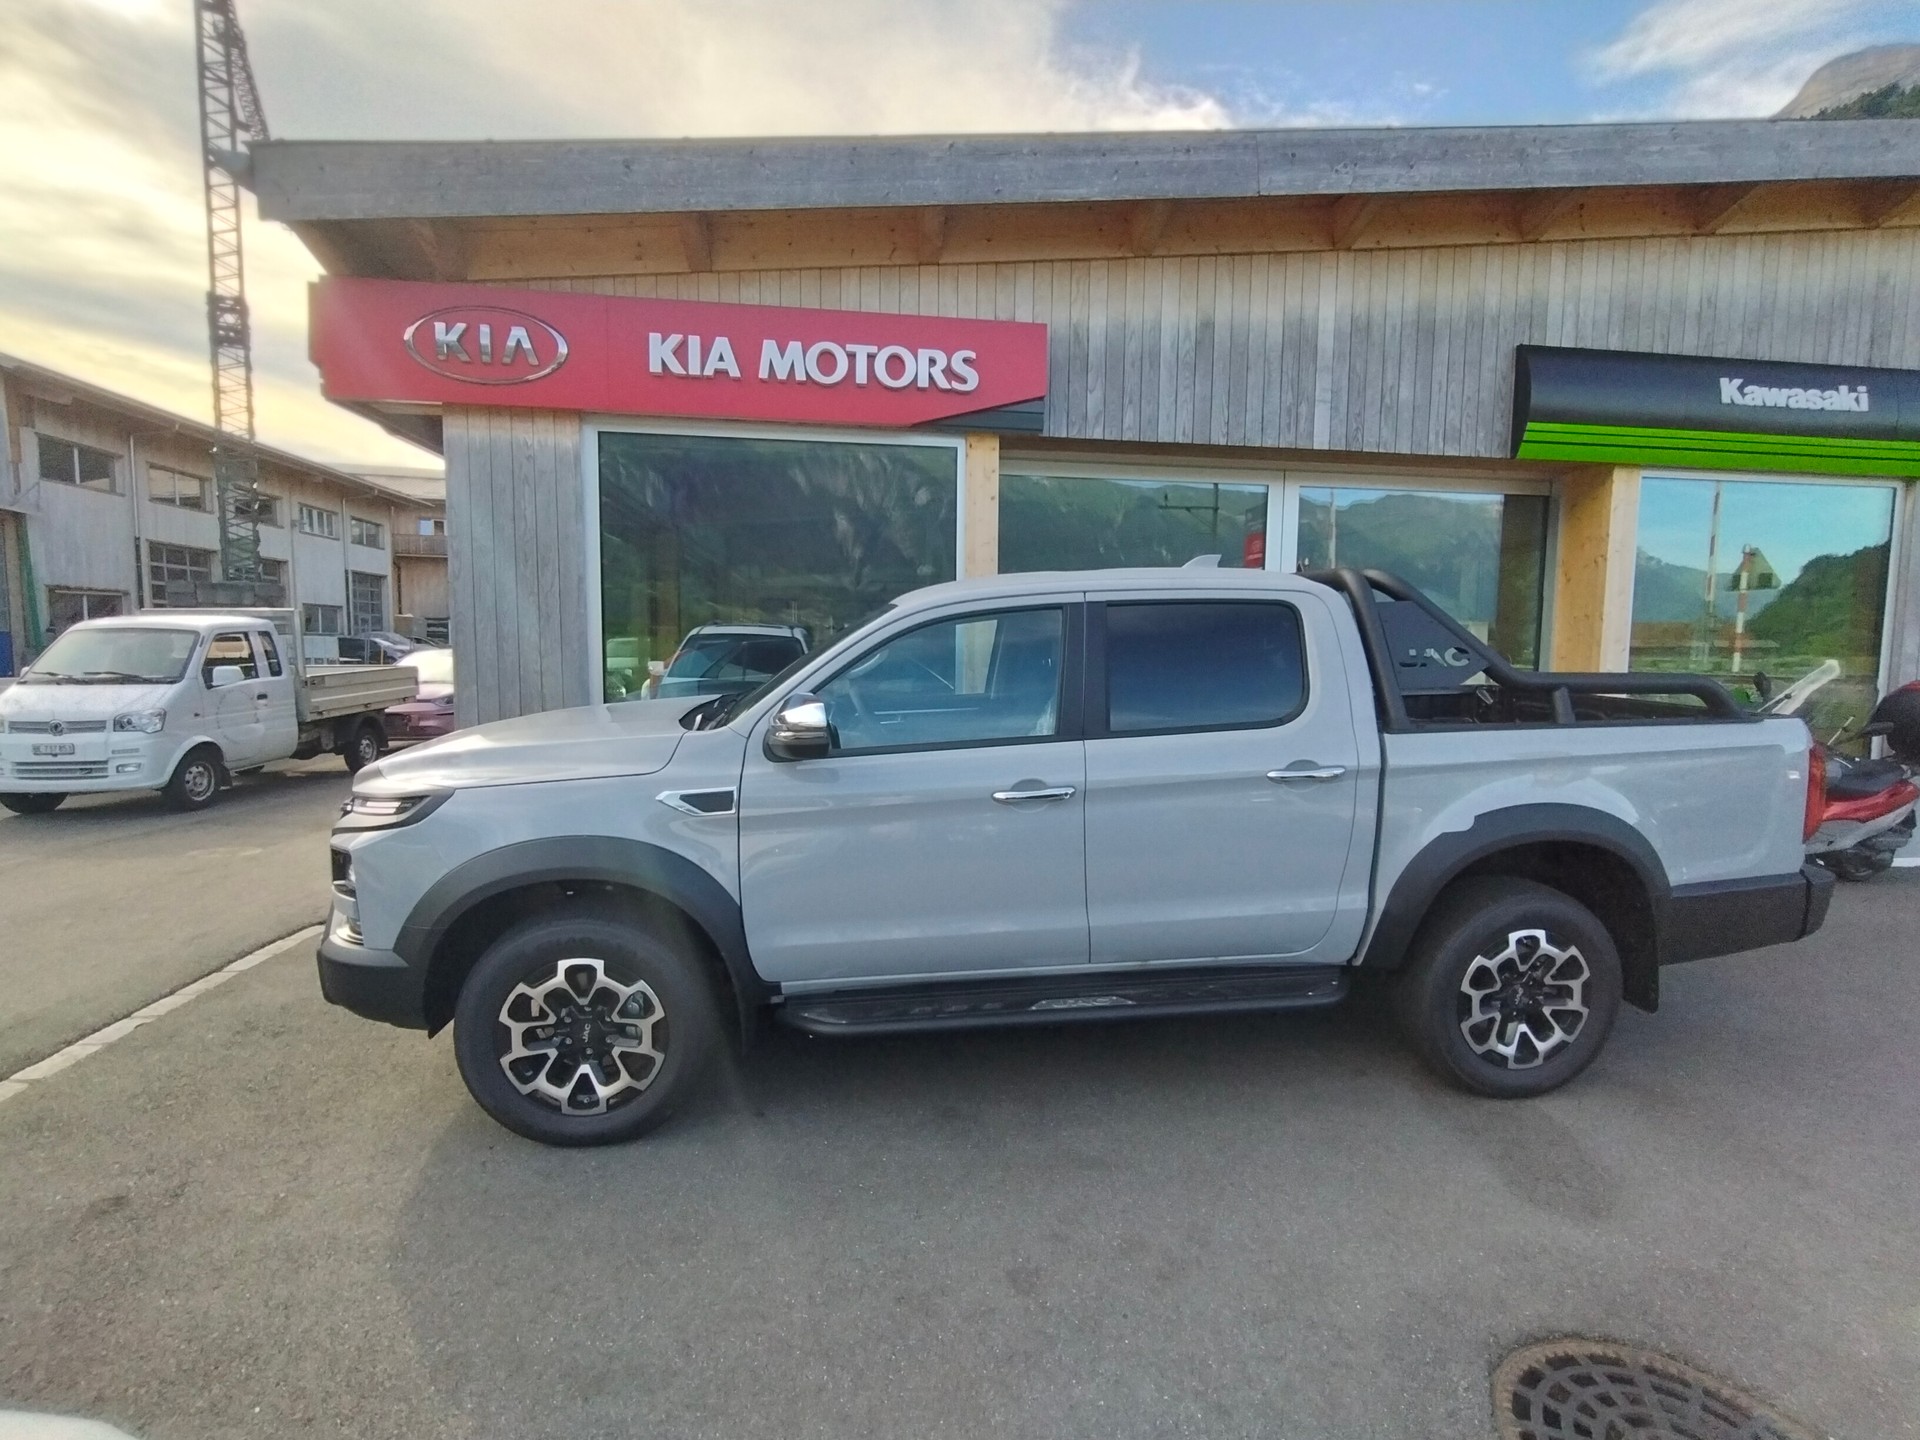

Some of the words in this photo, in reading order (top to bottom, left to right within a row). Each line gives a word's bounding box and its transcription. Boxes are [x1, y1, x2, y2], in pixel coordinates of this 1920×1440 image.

[433, 321, 540, 366] KIA
[648, 332, 742, 379] KIA
[757, 338, 980, 392] MOTORS
[1718, 376, 1870, 412] Kawasaki
[582, 1023, 592, 1043] JAC
